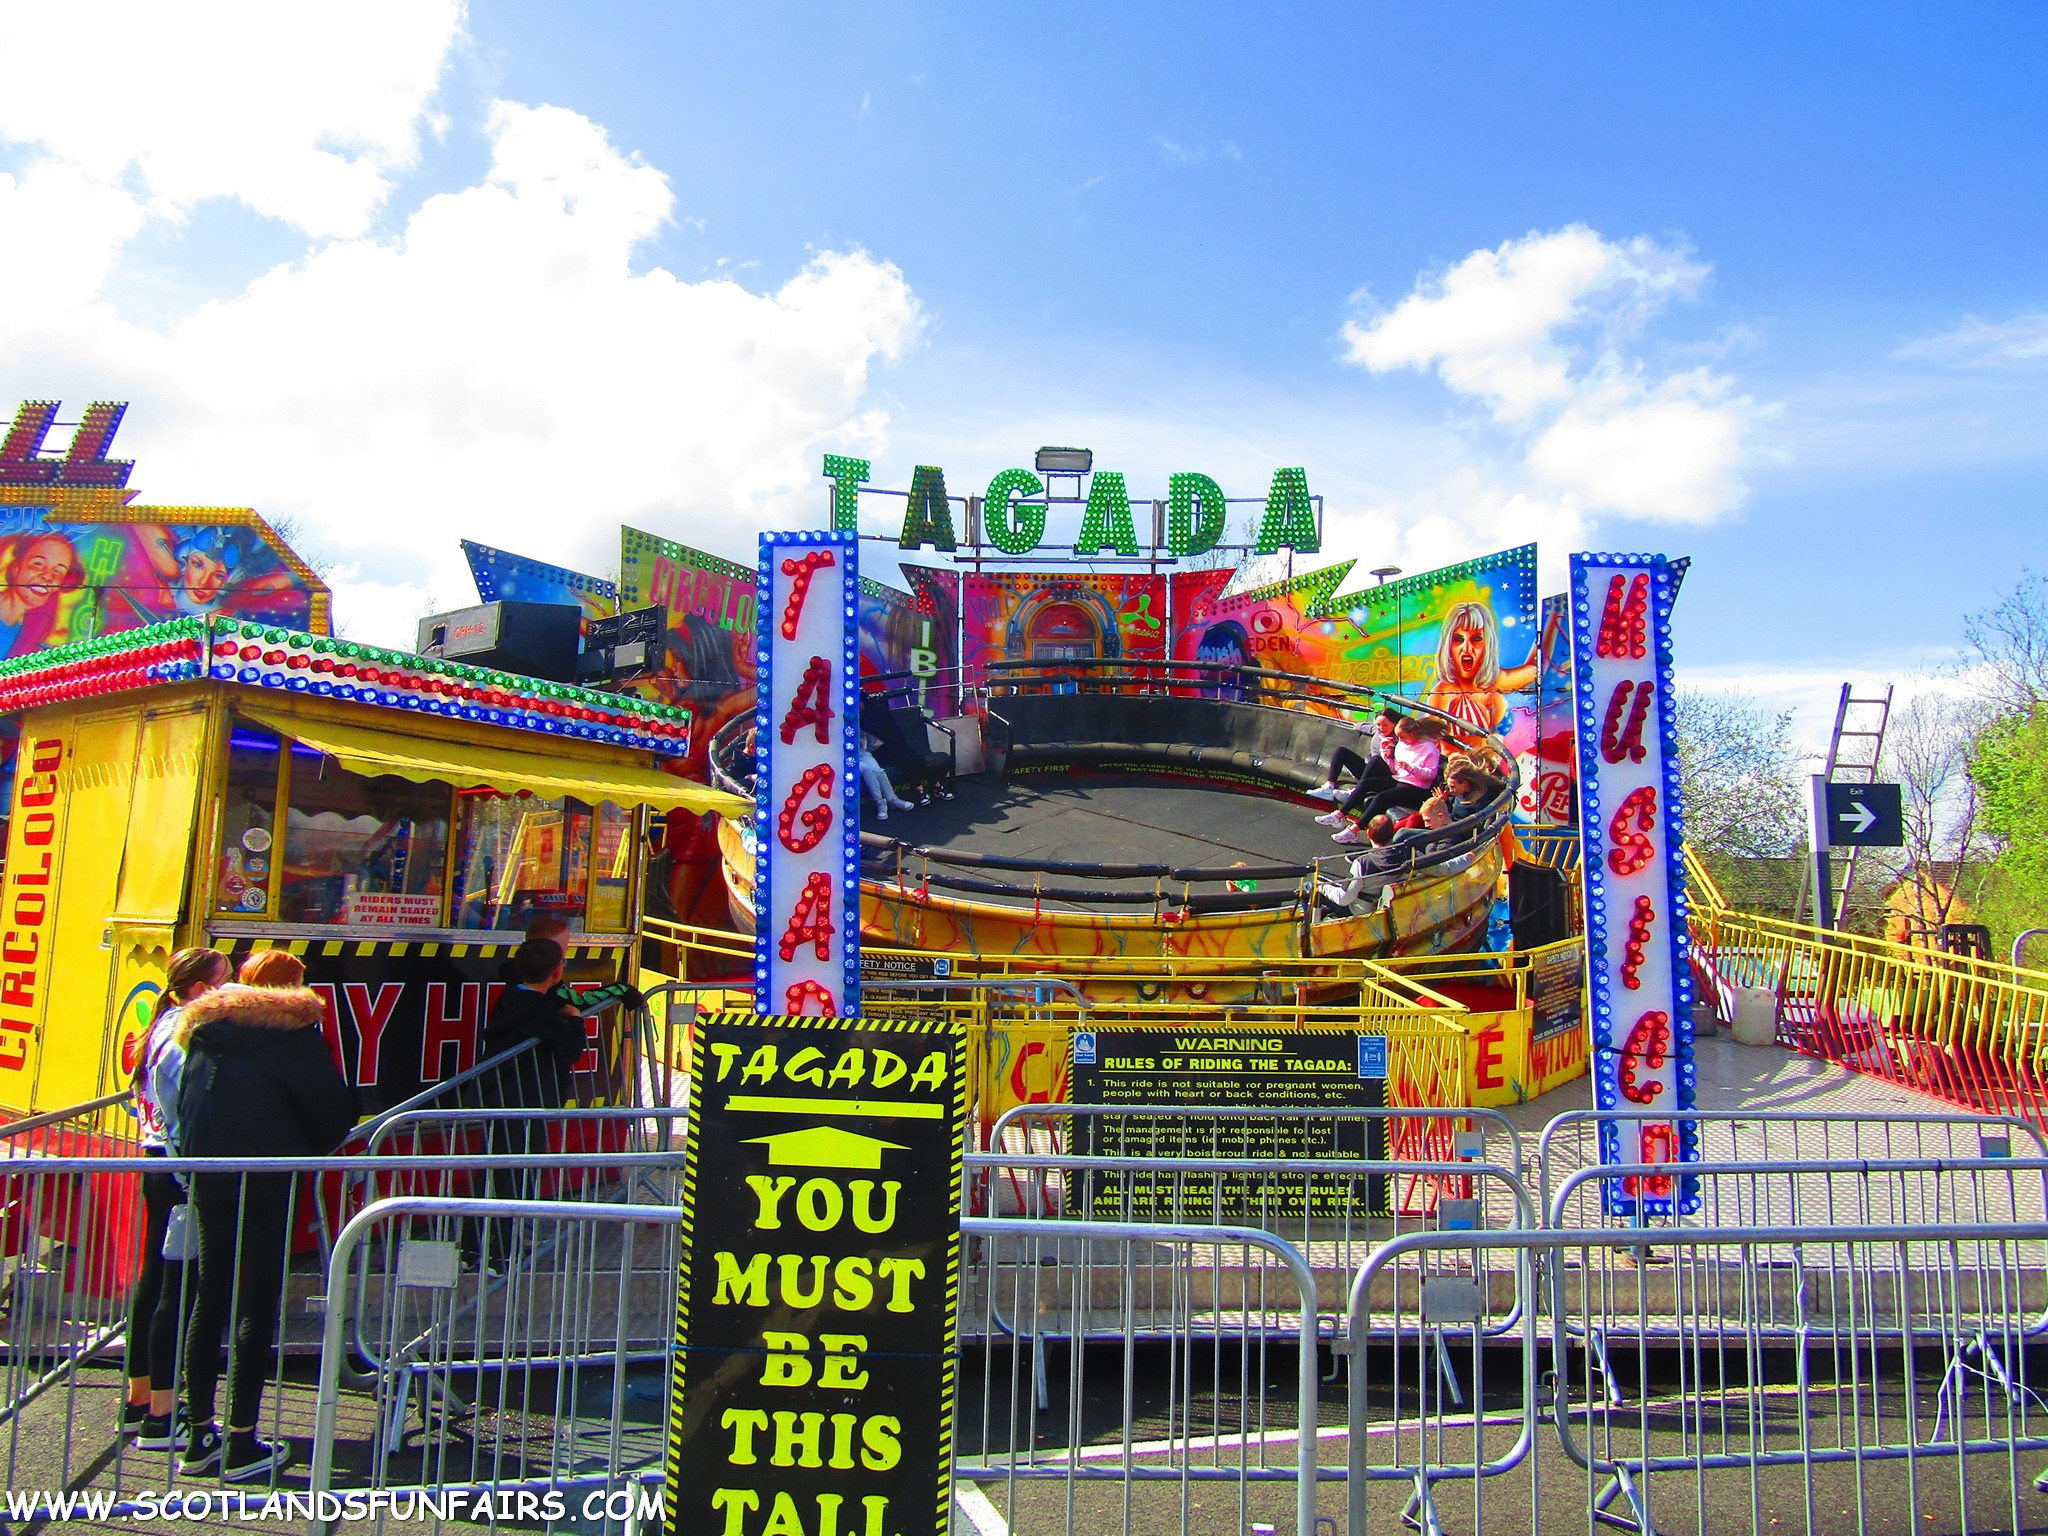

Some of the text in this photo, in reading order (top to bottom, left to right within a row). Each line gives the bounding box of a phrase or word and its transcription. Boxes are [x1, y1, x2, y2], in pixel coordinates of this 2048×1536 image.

[823, 454, 1320, 557] TAGADA
[650, 556, 759, 634] CIRCOLO
[360, 895, 436, 906] RIDERS MUST
[354, 905, 439, 915] REMAIN SEATED
[361, 915, 431, 924] AT ALL TIMES
[884, 961, 916, 970] NOTICE
[1174, 1037, 1283, 1051] WARNING
[710, 1042, 948, 1092] TAGADA
[1104, 1057, 1155, 1069] RULES
[1162, 1058, 1183, 1069] OF
[1189, 1058, 1243, 1070] RIDING
[1250, 1059, 1279, 1070] THE
[1285, 1059, 1352, 1071] TAGADA:
[1087, 1079, 1095, 1087] 1.
[1103, 1079, 1126, 1087] This
[1131, 1079, 1153, 1087] ride
[1158, 1079, 1168, 1087] is
[1172, 1080, 1191, 1088] not
[1196, 1080, 1240, 1089] suitable
[1266, 1081, 1316, 1091] pregnant
[1321, 1083, 1364, 1091] women,
[1103, 1089, 1142, 1098] people
[1147, 1089, 1170, 1097] with
[1175, 1089, 1204, 1098] heart
[1226, 1090, 1254, 1098] back
[1258, 1090, 1320, 1100] conditions,
[1325, 1091, 1346, 1099] etc.
[1103, 1125, 1122, 1133] The
[1196, 1126, 1205, 1134] is
[1312, 1127, 1331, 1135] lost
[1221, 1136, 1255, 1144] moble
[1131, 1149, 1141, 1157] is
[1158, 1150, 1182, 1158] very
[1252, 1150, 1274, 1158] ride
[1278, 1150, 1287, 1158] &
[1131, 1170, 1153, 1179] ide
[1183, 1171, 1228, 1181] flashig
[1282, 1172, 1318, 1180] stroe
[1103, 1186, 1129, 1194] ALL
[1134, 1186, 1174, 1195] MUST
[1256, 1186, 1304, 1195] ABOVE
[745, 1175, 902, 1234] YOU
[1094, 1196, 1122, 1205] AND
[1164, 1196, 1213, 1205] RDING
[711, 1251, 926, 1313] MUST
[759, 1331, 870, 1390] BE
[720, 1407, 902, 1471] THIS
[711, 1487, 902, 1536] TALL
